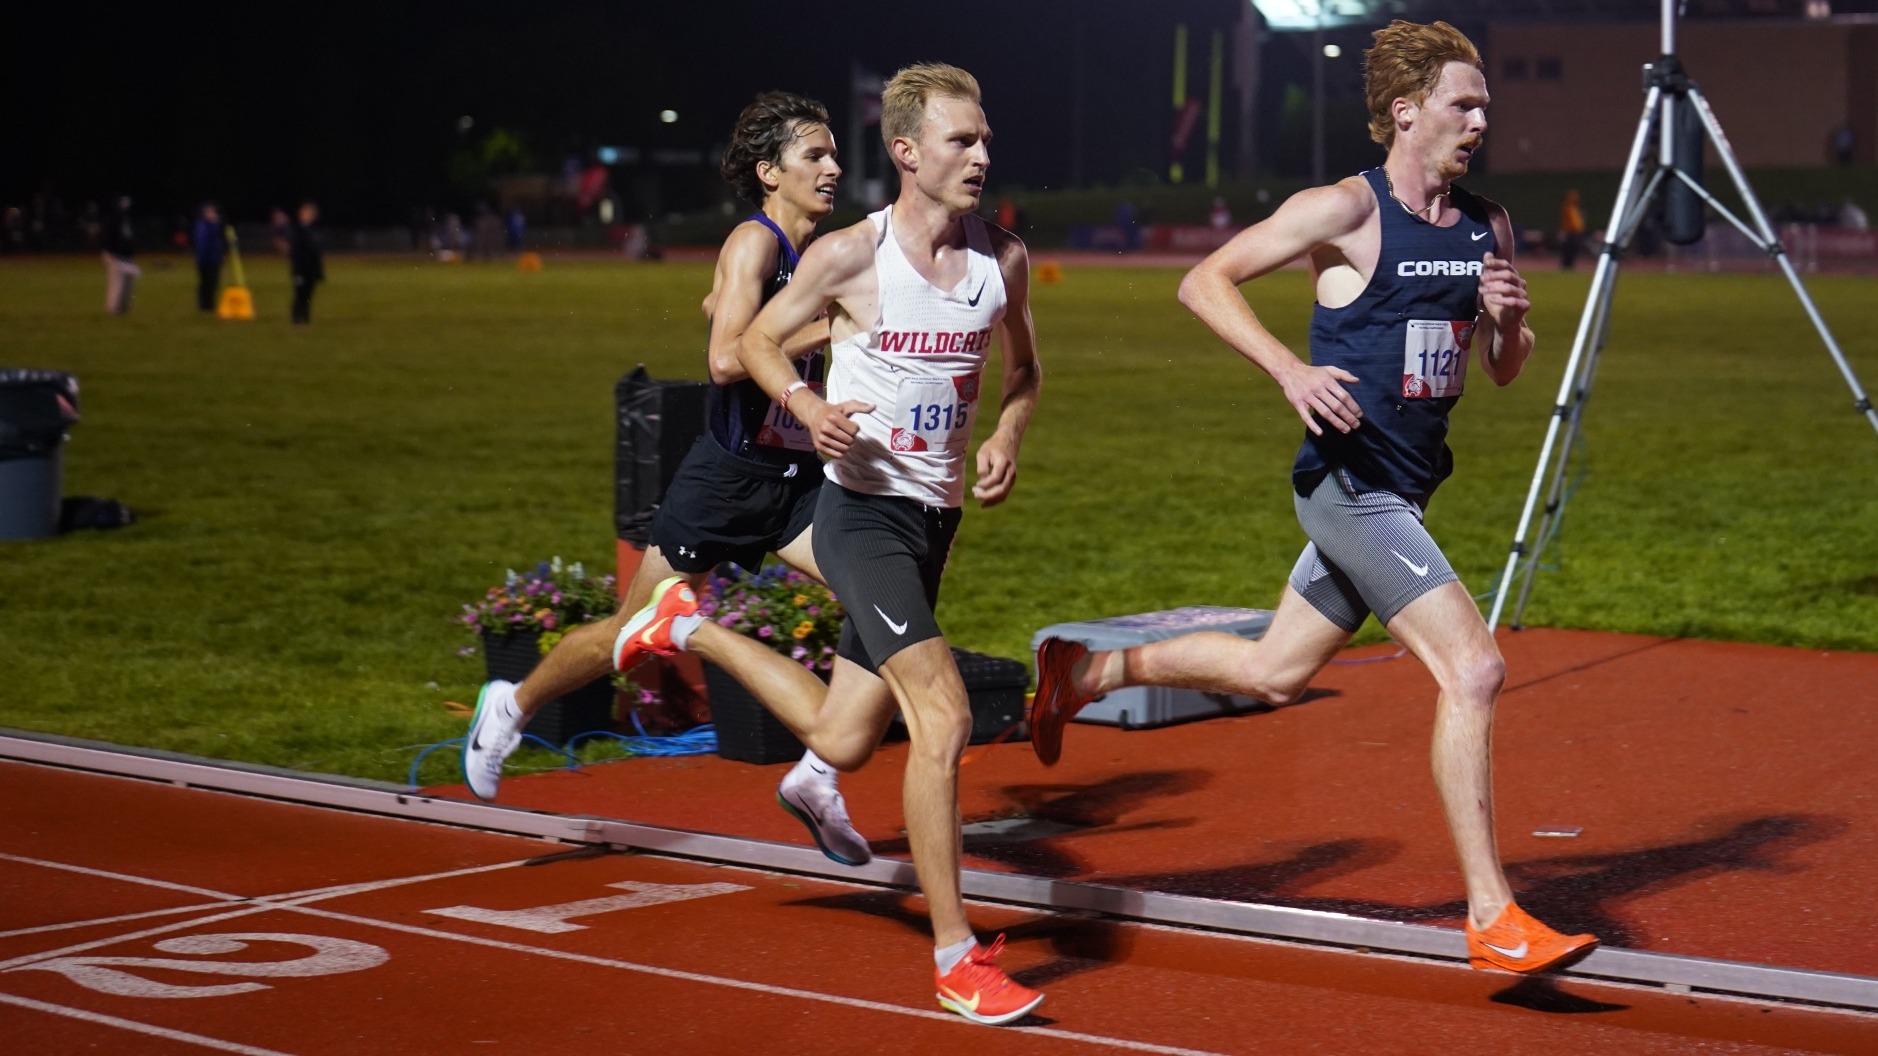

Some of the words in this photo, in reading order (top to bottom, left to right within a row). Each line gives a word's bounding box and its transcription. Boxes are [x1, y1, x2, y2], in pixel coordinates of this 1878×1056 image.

[1418, 348, 1461, 377] 1121
[773, 405, 805, 431] 10
[910, 402, 968, 431] 1315
[422, 879, 755, 935] 1
[1, 932, 391, 999] 2
